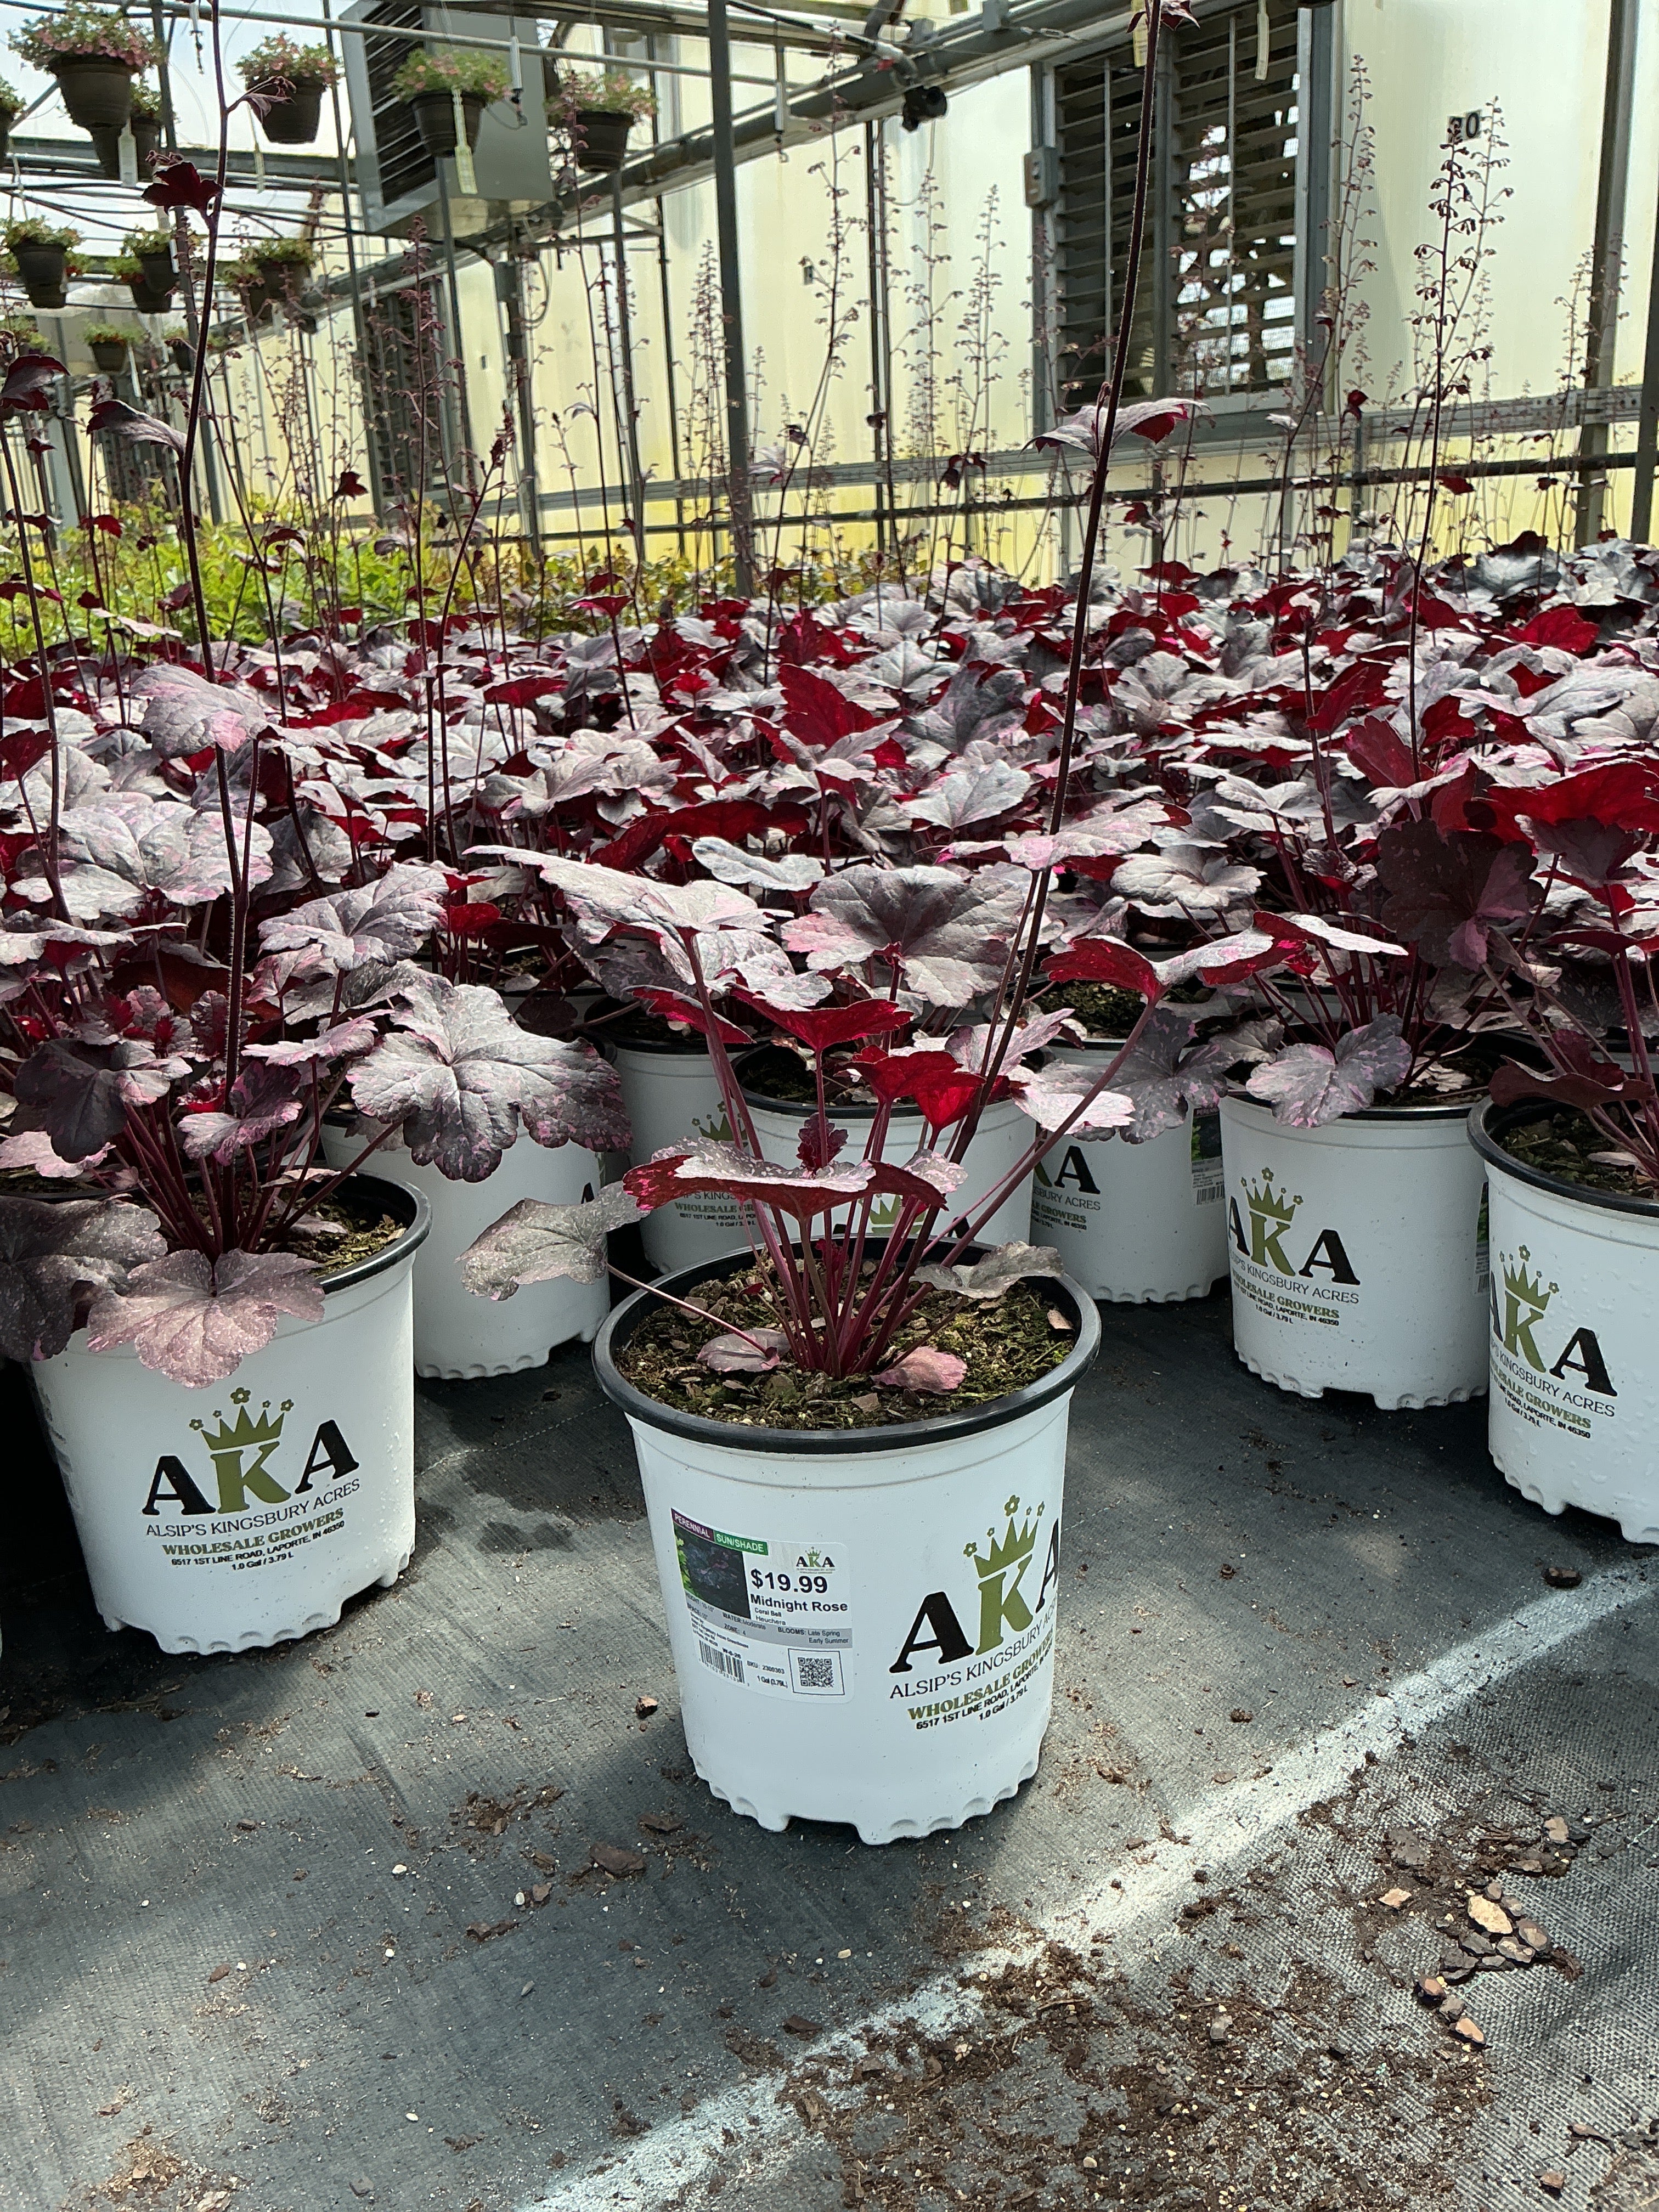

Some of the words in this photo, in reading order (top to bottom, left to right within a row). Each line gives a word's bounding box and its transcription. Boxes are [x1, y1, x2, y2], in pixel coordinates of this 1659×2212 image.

[675, 1202, 737, 1213] WHOLESALE
[1042, 1205, 1086, 1223] GROWERS
[1065, 1197, 1101, 1211] ACRES
[1229, 1196, 1361, 1285] AKA
[1247, 1263, 1310, 1295] KINGSBURY
[1312, 1288, 1359, 1304] ACRES
[1277, 1296, 1340, 1318] GROWERS
[1499, 1348, 1560, 1397] KINGSBURY
[1562, 1392, 1615, 1417] ACRES
[1525, 1391, 1591, 1429] GROWERS
[1567, 1426, 1591, 1439] 46350
[142, 1419, 360, 1515] AKA
[146, 1524, 207, 1537] ALSIP'S
[211, 1500, 310, 1534] KINGSBURY
[313, 1479, 360, 1510] ACRES
[162, 1534, 265, 1555] WHOLESALE
[268, 1508, 344, 1543] GROWERS
[674, 1513, 710, 1538] PERENNIAL
[212, 1555, 233, 1564] LINE
[235, 1548, 266, 1561] ROAD,
[267, 1535, 311, 1554] LAPORTE,
[312, 1531, 321, 1540] IN
[323, 1520, 345, 1535] 46350
[716, 1533, 764, 1552] SUN/SHADE
[246, 1559, 262, 1569] Gal
[268, 1554, 286, 1564] 3.79
[795, 1556, 835, 1567] AKA
[751, 1568, 828, 1594] $19.99
[750, 1593, 808, 1612] Midnight
[811, 1601, 848, 1612] Rose
[754, 1607, 769, 1615] Coral
[755, 1615, 786, 1626] Heuchera
[777, 1627, 806, 1635] BLOOMS:
[889, 1671, 962, 1699] ALSIP'S
[966, 1619, 1042, 1681] KINGSBURY
[907, 1672, 1011, 1720] WHOLESALE
[916, 1718, 940, 1730] 6517
[943, 1711, 960, 1723] 1ST
[962, 1702, 983, 1717] LINE
[984, 1689, 1009, 1707] ROAD,
[979, 1709, 991, 1720] 1.0
[992, 1701, 1005, 1714] Gal
